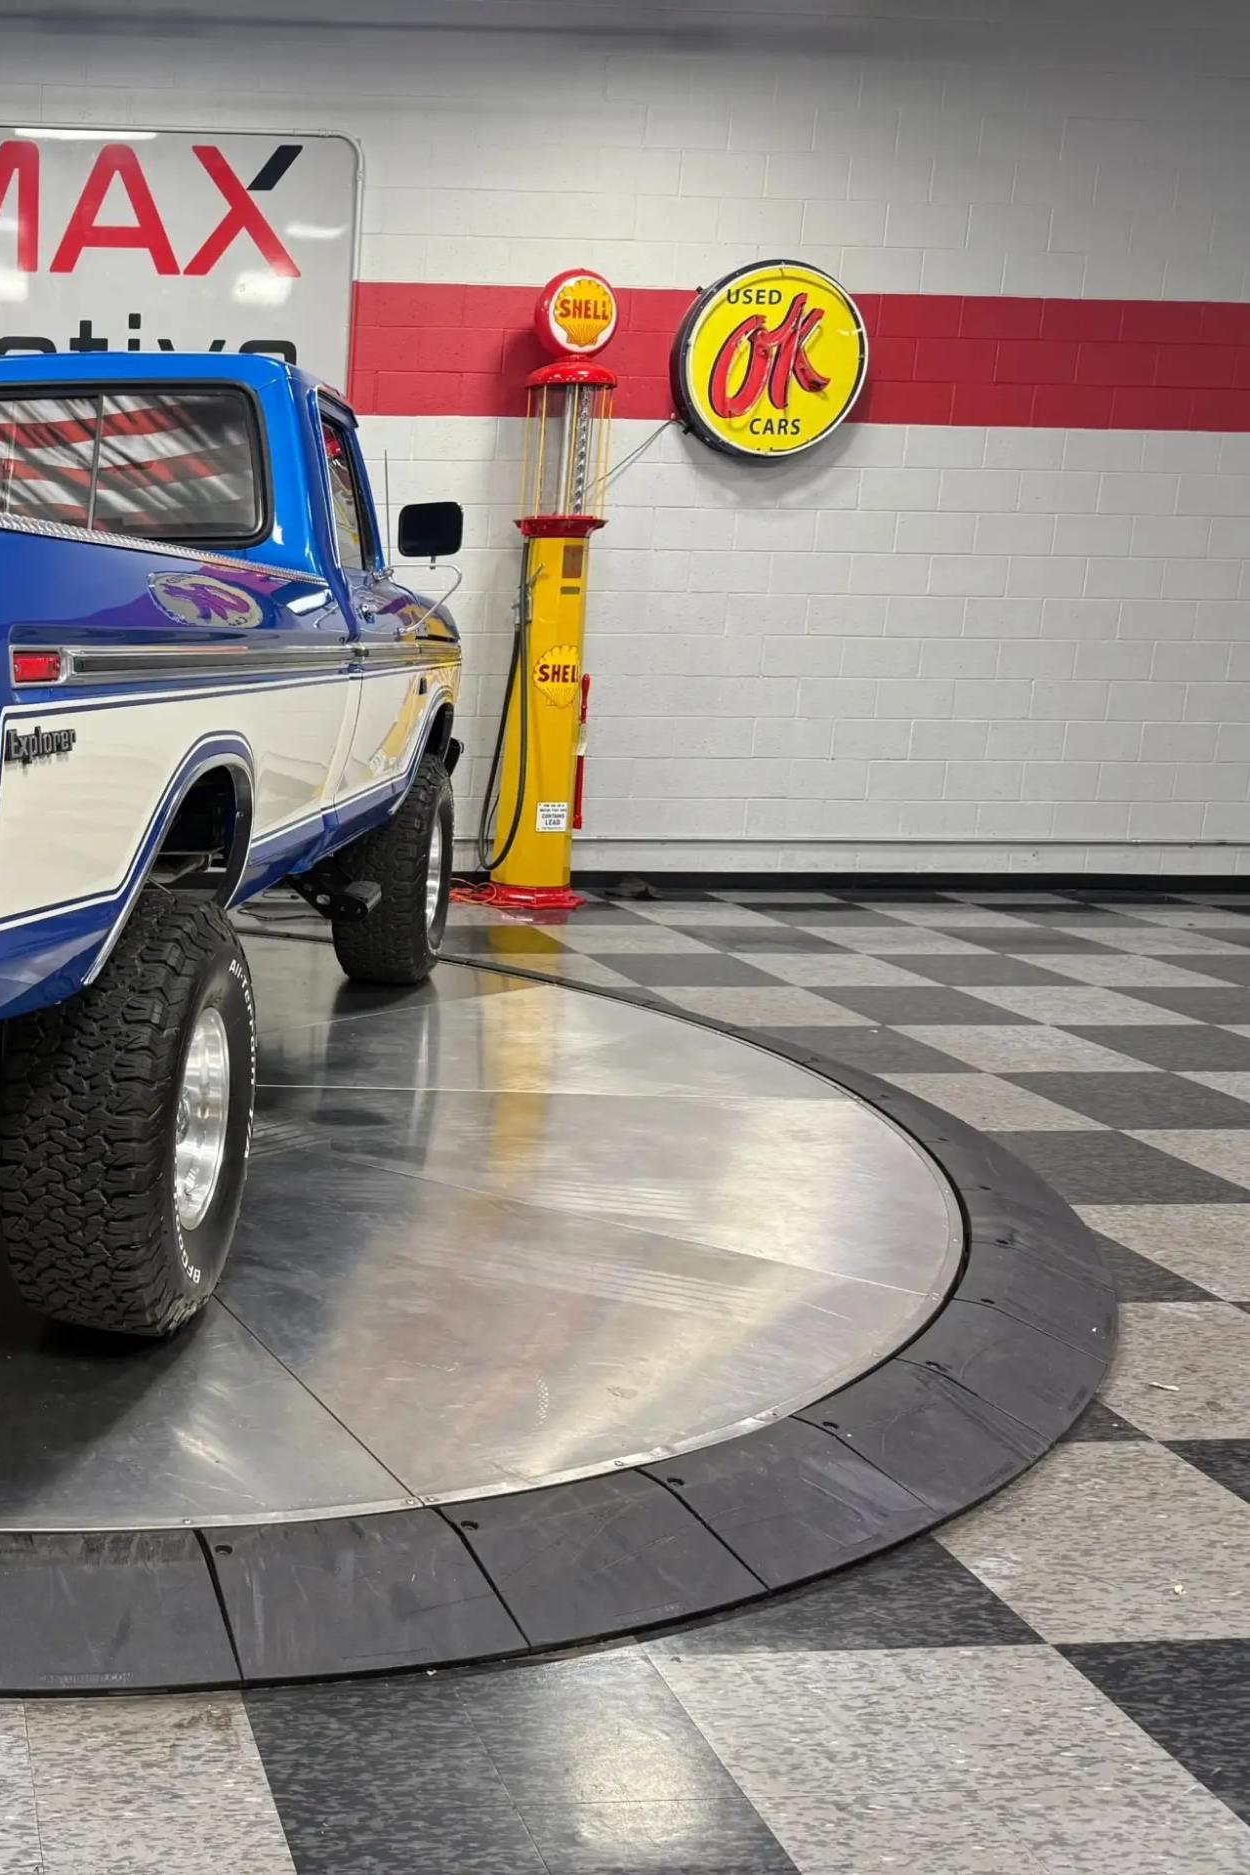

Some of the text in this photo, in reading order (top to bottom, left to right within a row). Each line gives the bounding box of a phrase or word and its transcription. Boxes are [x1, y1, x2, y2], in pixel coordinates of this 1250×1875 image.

[727, 288, 782, 305] USED
[559, 298, 609, 322] SHELL
[708, 292, 832, 419] OK
[749, 418, 801, 436] CARS
[6, 726, 76, 766] Explorer
